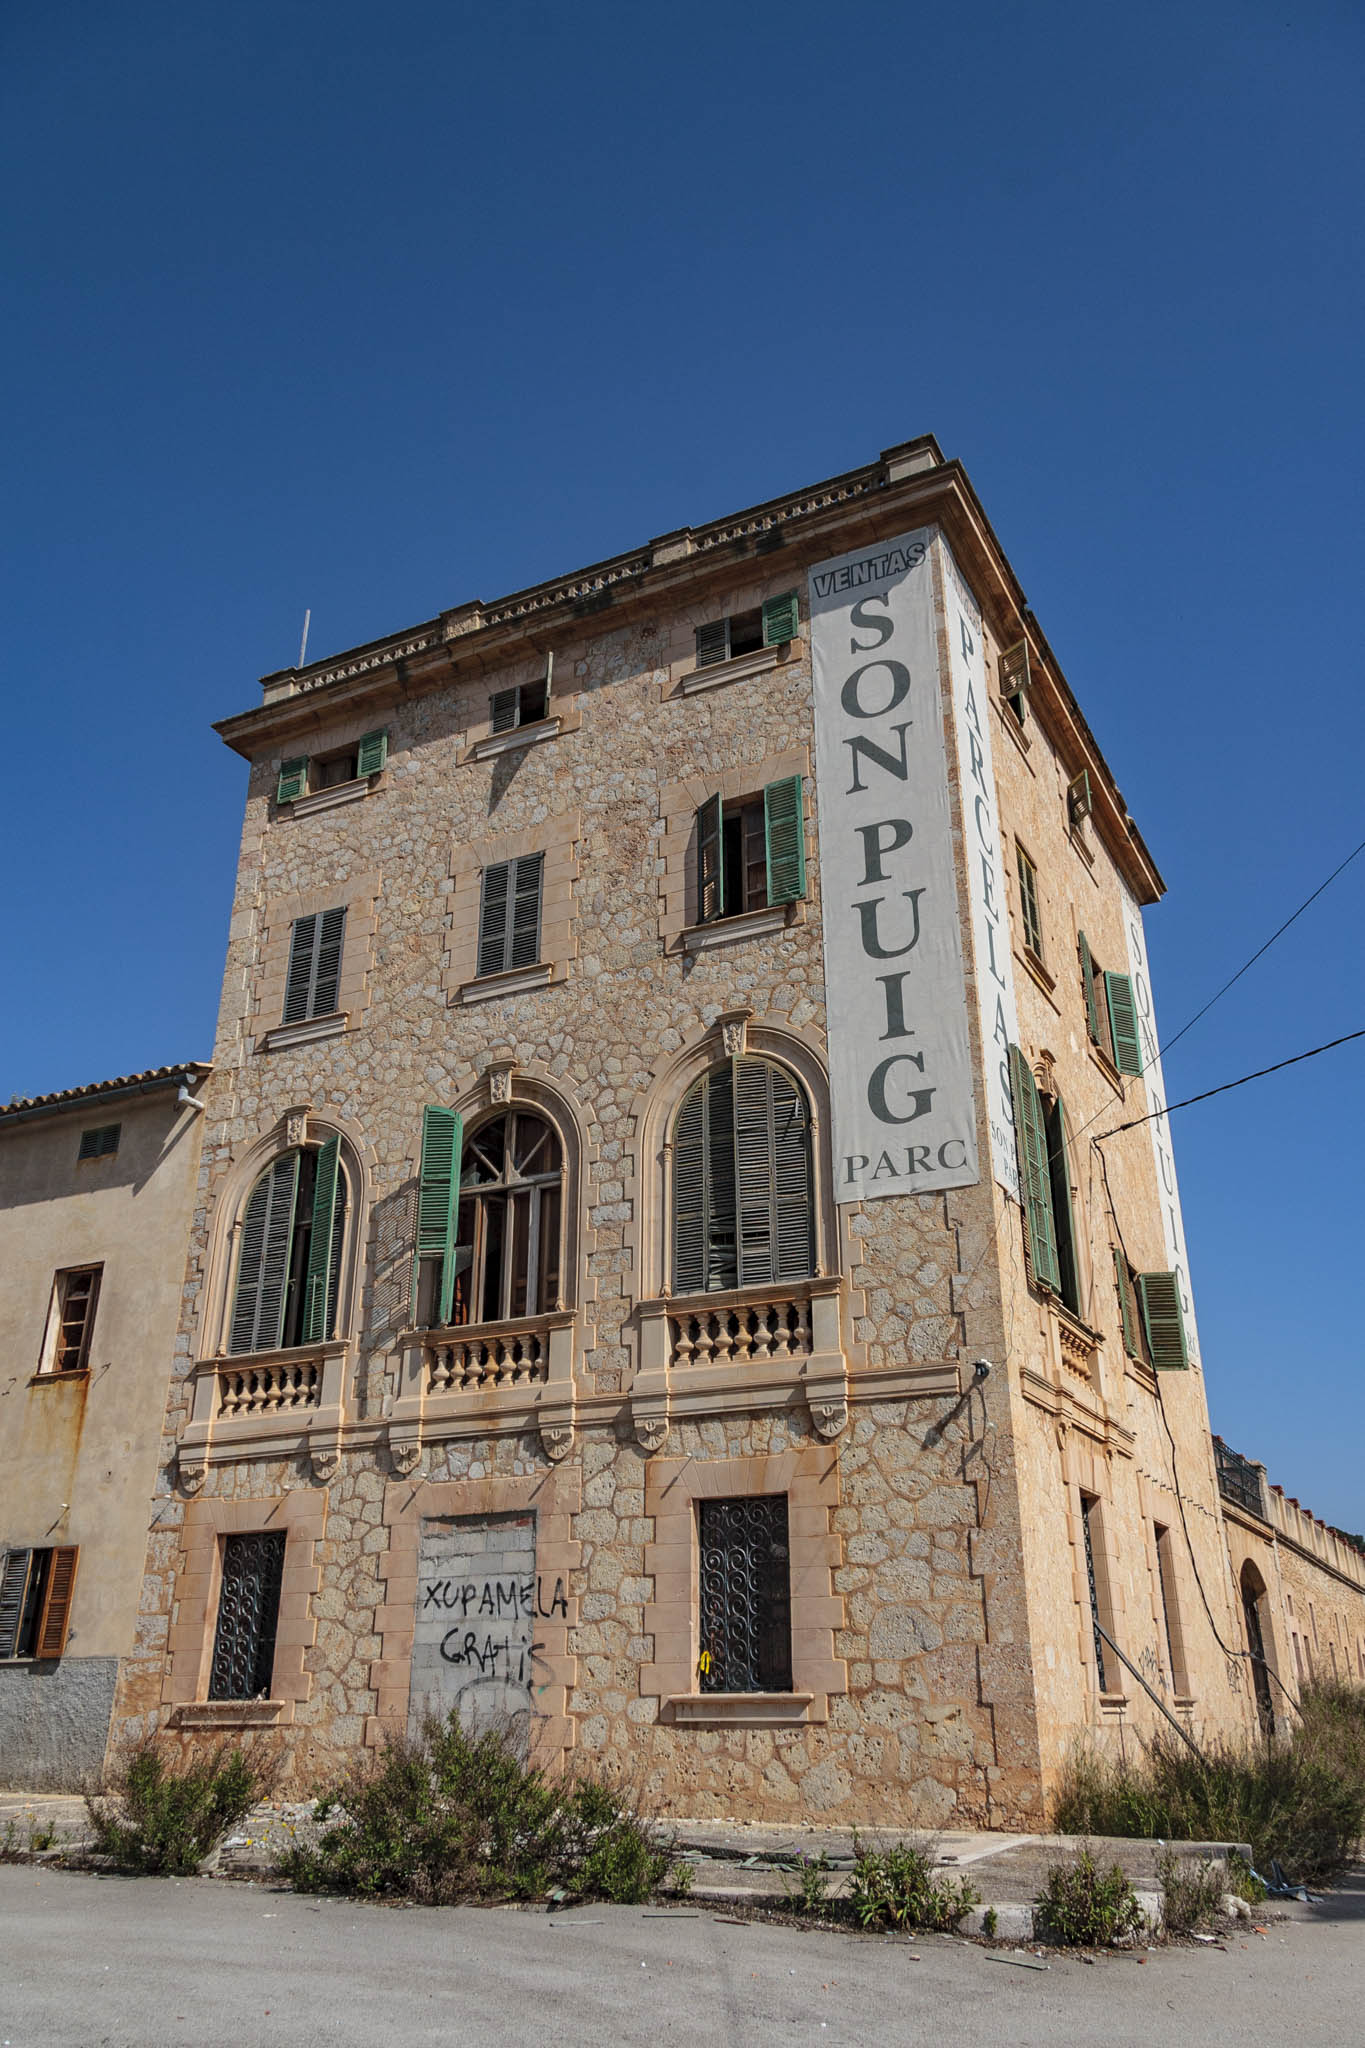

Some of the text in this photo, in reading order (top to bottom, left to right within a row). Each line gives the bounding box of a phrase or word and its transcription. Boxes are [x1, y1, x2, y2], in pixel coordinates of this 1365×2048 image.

[813, 542, 926, 598] VENTAS
[840, 591, 937, 1125] SON PUIG
[843, 1138, 968, 1184] PARC
[424, 1575, 568, 1620] XUPAMELA
